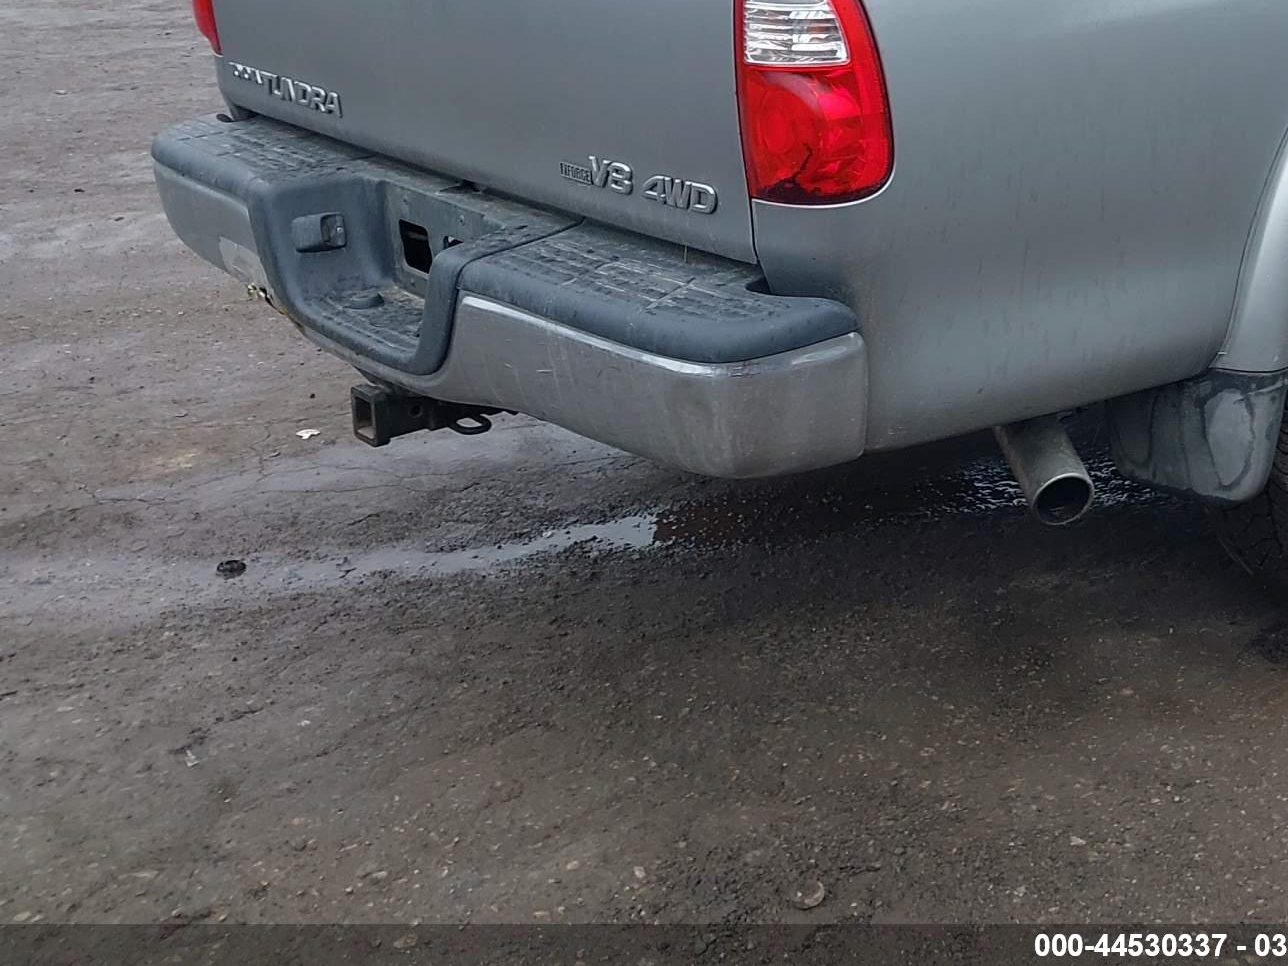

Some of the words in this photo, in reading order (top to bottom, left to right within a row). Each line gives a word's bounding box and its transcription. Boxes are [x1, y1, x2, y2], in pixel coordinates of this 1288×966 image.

[258, 70, 343, 118] TUNDRA
[588, 155, 633, 195] V8
[642, 175, 718, 215] 4WD
